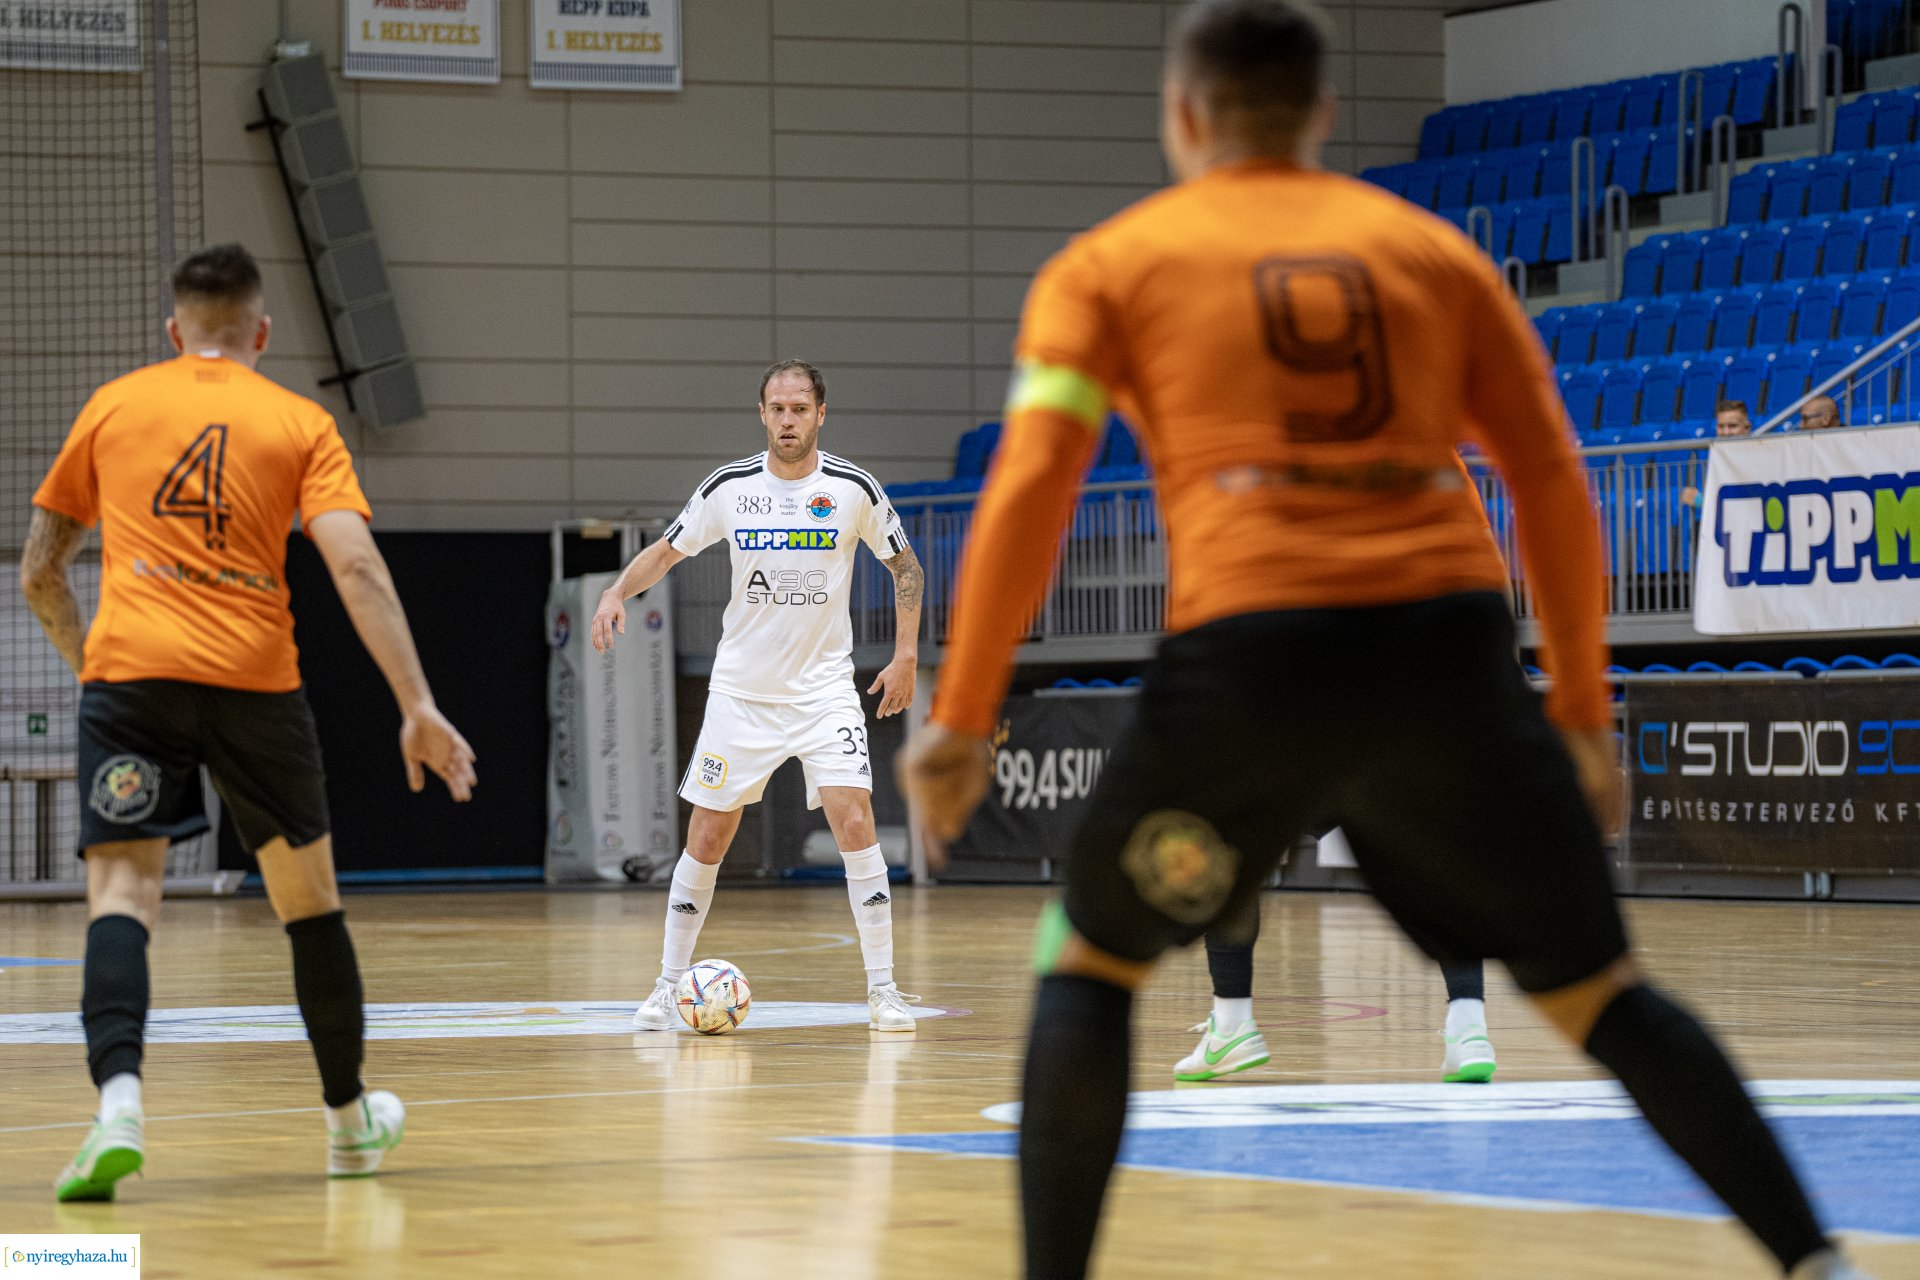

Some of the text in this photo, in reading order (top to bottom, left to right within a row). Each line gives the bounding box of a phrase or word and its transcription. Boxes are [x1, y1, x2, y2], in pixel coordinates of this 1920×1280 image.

[380, 18, 480, 44] HELYEZÉS
[564, 26, 662, 53] HELYEZÉS
[1253, 255, 1395, 443] 9
[153, 423, 231, 549] 4
[736, 494, 772, 515] 383
[747, 592, 828, 606] STUDIO
[837, 727, 868, 757] 33
[1856, 719, 1920, 775] 90
[703, 757, 723, 772] 99.4
[703, 774, 714, 784] FM
